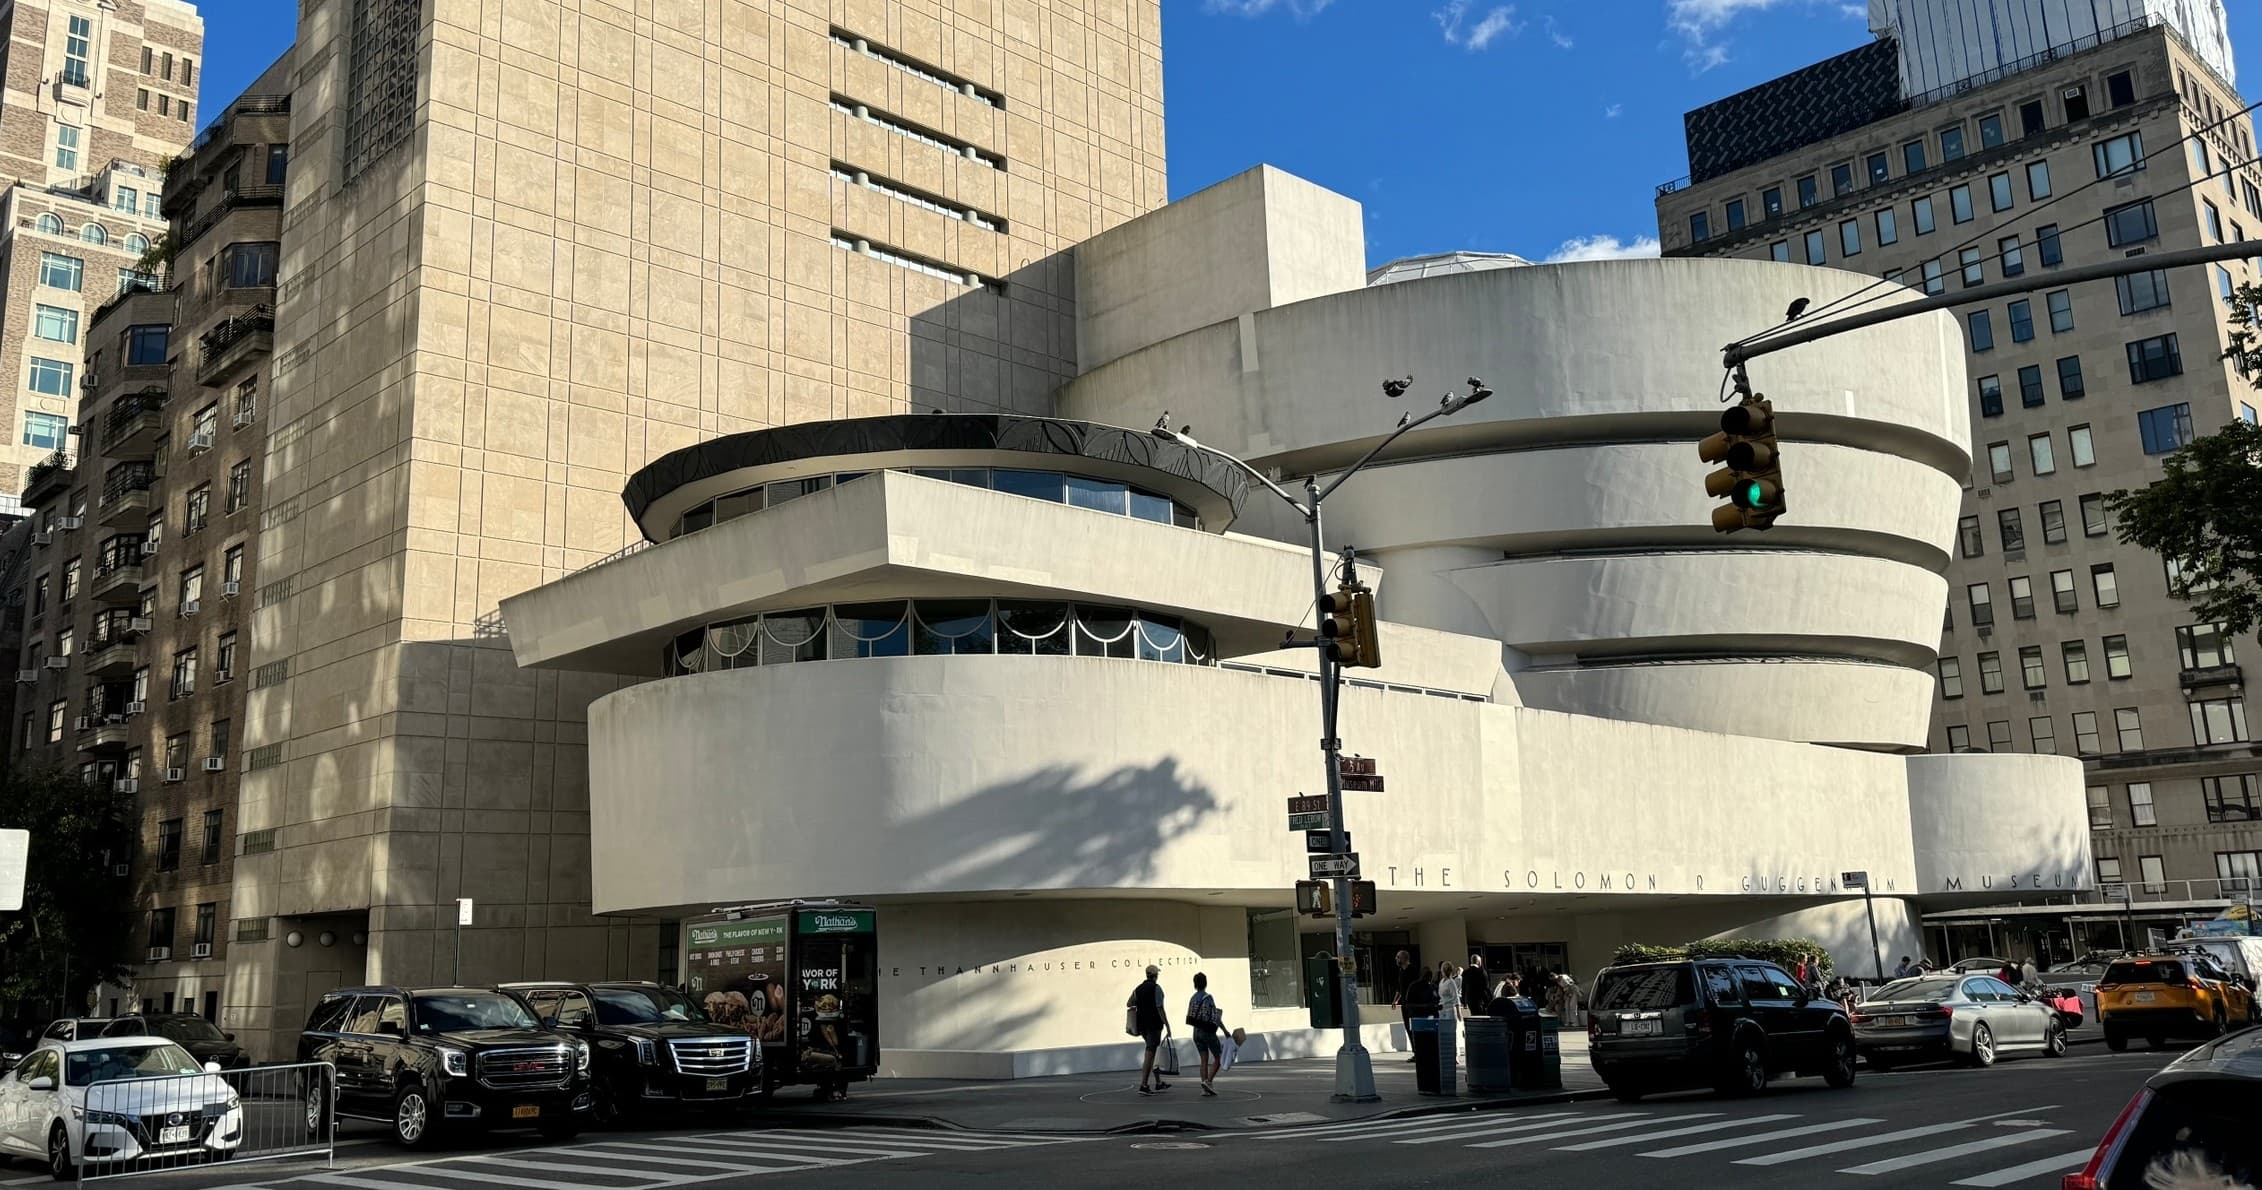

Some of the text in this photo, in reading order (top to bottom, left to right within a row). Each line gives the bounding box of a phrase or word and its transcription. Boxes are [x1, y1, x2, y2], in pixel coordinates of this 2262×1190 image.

[1295, 801, 1300, 811] E
[1301, 800, 1311, 811] 89
[1313, 860, 1349, 871] ONE WAY
[1388, 866, 1451, 887] THE
[1504, 869, 1656, 890] SOLOMON
[1696, 874, 1704, 891] R
[1742, 875, 1895, 892] GUGGENIM
[731, 930, 751, 938] FLAVOR
[758, 928, 769, 936] NEW
[826, 968, 839, 977] OF
[919, 961, 1096, 976] THANNHAUSER
